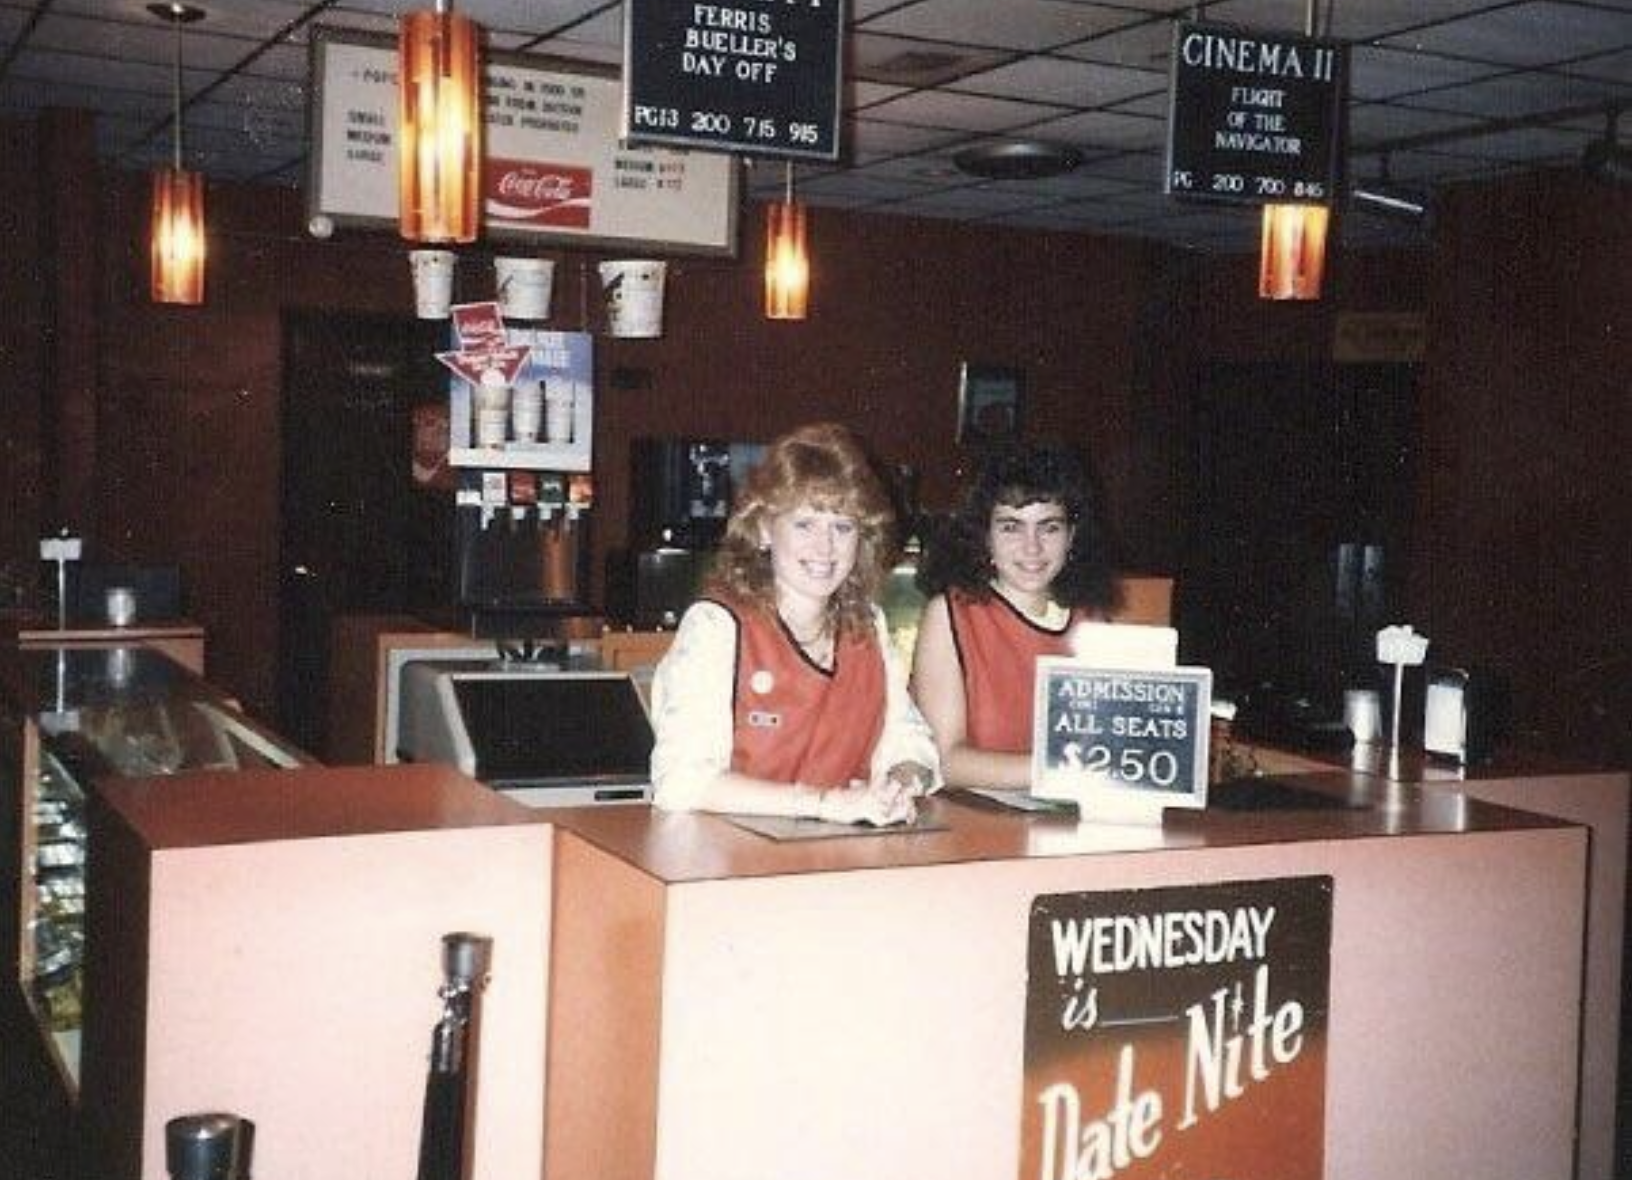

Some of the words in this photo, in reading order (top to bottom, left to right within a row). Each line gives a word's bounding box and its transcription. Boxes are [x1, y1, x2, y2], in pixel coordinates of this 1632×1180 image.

[694, 4, 771, 34] FERRIS
[684, 29, 797, 61] BUELLER'S
[1182, 33, 1304, 79] CINEMA
[1313, 48, 1334, 82] II
[682, 52, 726, 77] DAY
[735, 60, 777, 83] OFF
[1231, 87, 1285, 109] FLIGHT
[634, 105, 680, 128] PG13
[691, 111, 731, 135] 200
[743, 117, 776, 140] 715
[789, 122, 819, 144] 915
[1226, 110, 1248, 129] OF
[1255, 114, 1286, 133] THE
[1215, 131, 1303, 156] NAVIGATOR
[496, 170, 574, 201] Coca-Cola
[1174, 170, 1194, 189] PG
[1213, 173, 1245, 193] 200
[1058, 679, 1186, 704] ADMISSION
[1055, 713, 1104, 736] ALL
[1112, 716, 1188, 740] SEATS
[1051, 906, 1275, 977] WEDNESDAY
[1062, 977, 1099, 1031] is
[1038, 1043, 1163, 1180] Date
[1176, 964, 1306, 1131] Nite
